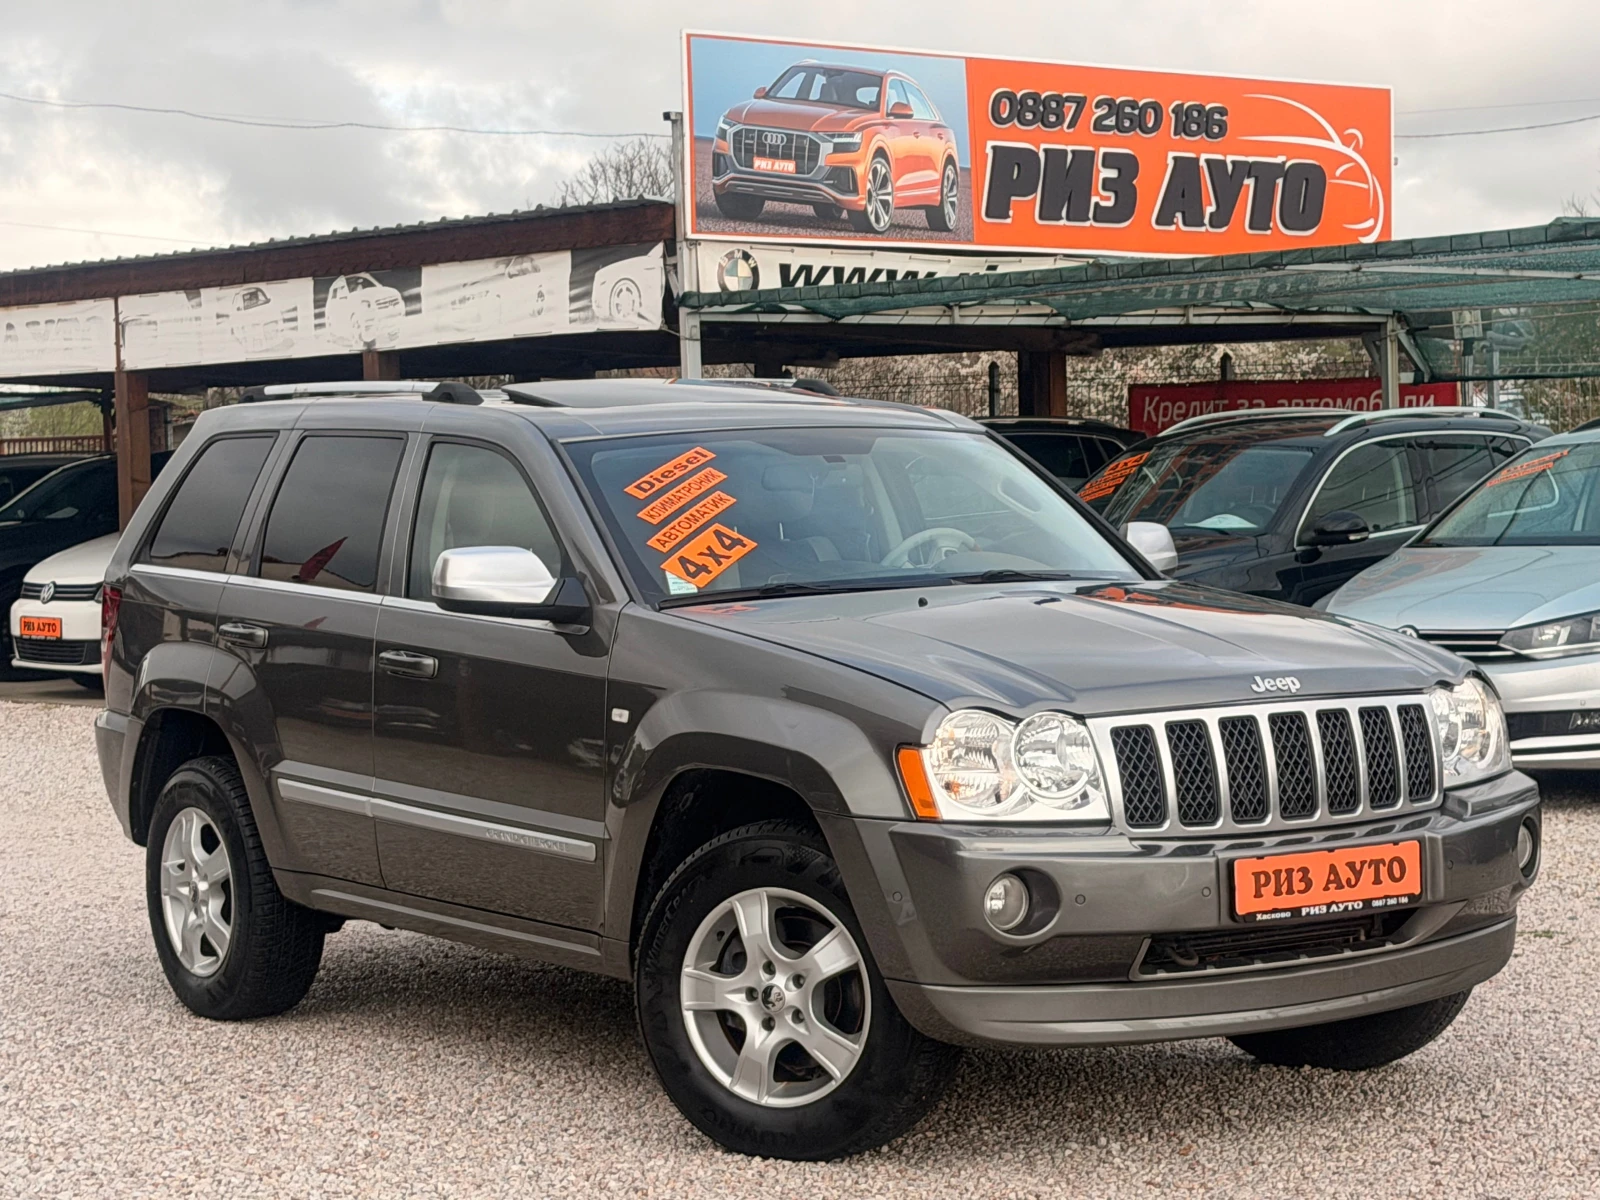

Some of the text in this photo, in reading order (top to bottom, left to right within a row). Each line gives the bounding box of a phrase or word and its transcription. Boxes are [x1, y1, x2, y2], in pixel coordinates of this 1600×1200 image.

[990, 88, 1228, 141] 0887 260 186
[982, 140, 1327, 236] РИЗ АУТО
[1143, 395, 1229, 429] Кредит
[634, 450, 709, 493] Diesel
[644, 470, 721, 520] КЛИМАТРОНИК
[656, 493, 731, 548] АВТОМАТИК
[677, 528, 748, 579] 4x4
[37, 621, 57, 633] АУТО
[1250, 675, 1301, 693] Jeep
[1251, 856, 1407, 898] РИЗ АУТО
[1256, 911, 1292, 921] Хасково
[1301, 905, 1327, 917] РИЗ
[1329, 901, 1363, 913] АУТО
